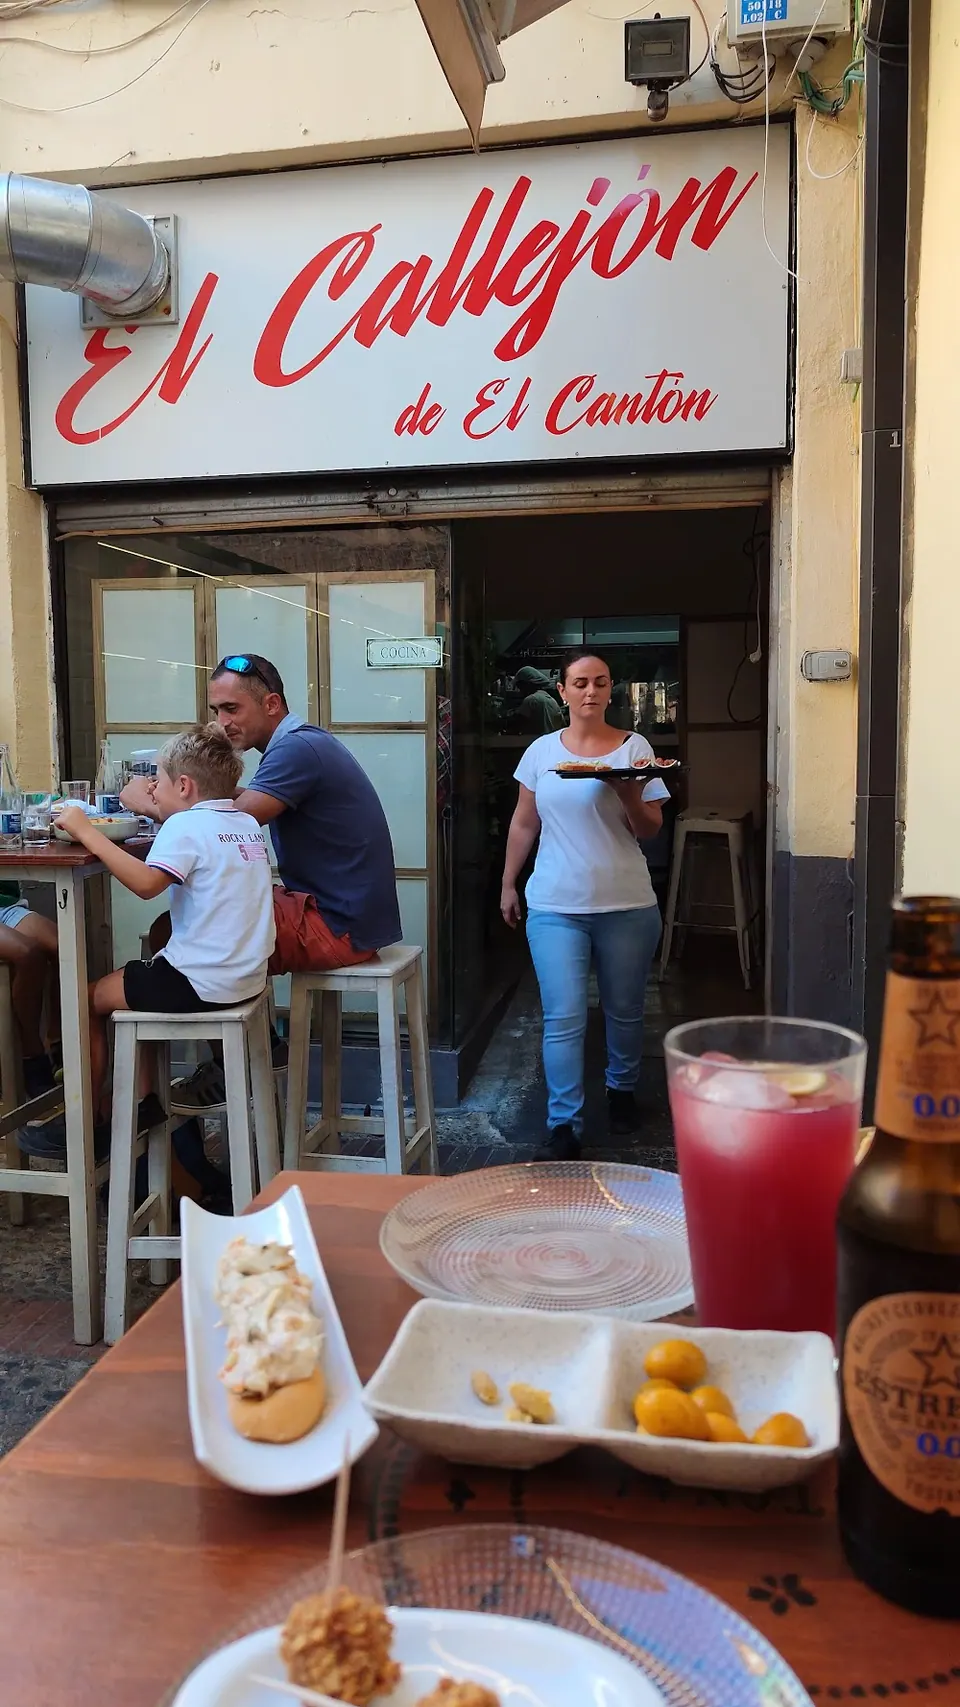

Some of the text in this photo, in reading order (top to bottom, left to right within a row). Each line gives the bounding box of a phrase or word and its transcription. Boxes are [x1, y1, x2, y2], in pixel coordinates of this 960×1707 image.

[774, 10, 782, 19] C
[54, 164, 759, 446] El Callejón
[393, 368, 719, 440] de El Cantón
[889, 430, 901, 448] 1
[380, 646, 427, 659] COCINA
[217, 833, 246, 843] ROCKY
